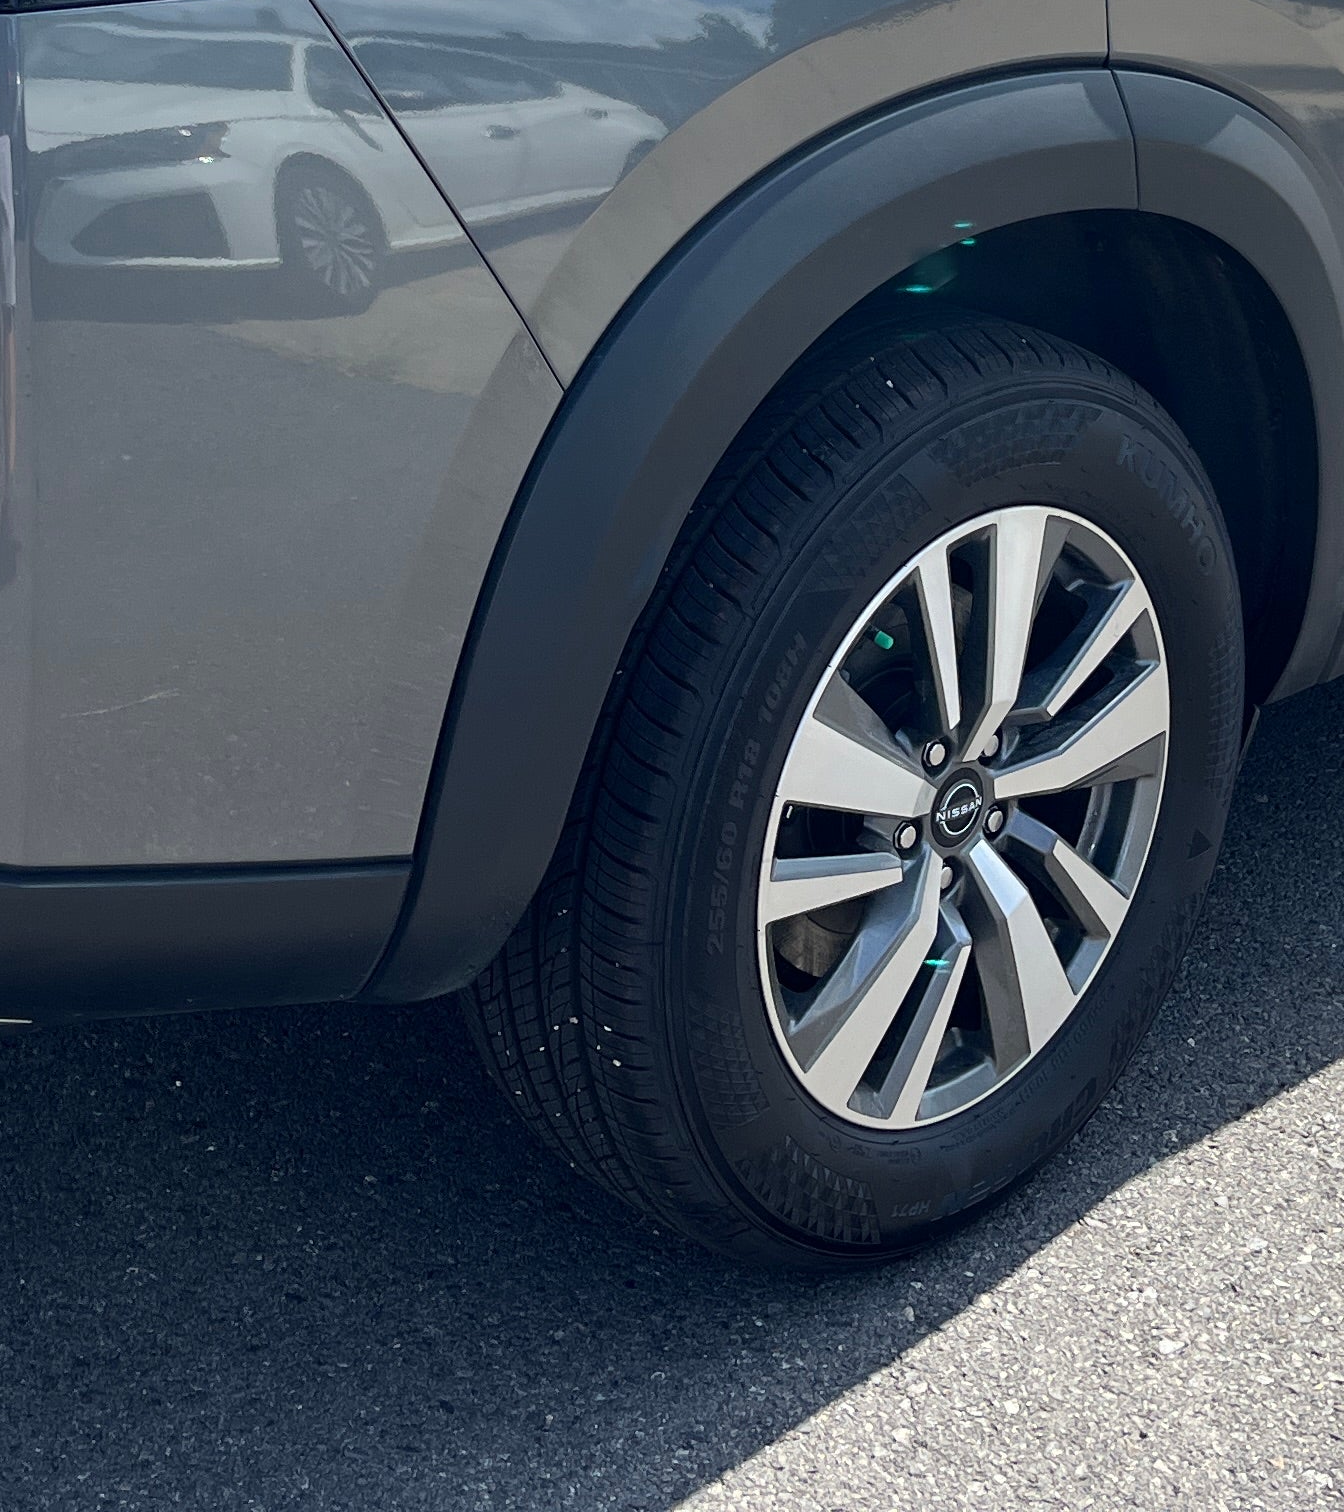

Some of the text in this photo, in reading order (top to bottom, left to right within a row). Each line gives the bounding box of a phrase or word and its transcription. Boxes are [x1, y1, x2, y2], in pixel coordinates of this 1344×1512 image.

[1115, 433, 1219, 578] KUMHO
[936, 795, 983, 822] NISSAN
[706, 821, 742, 958] 255/60
